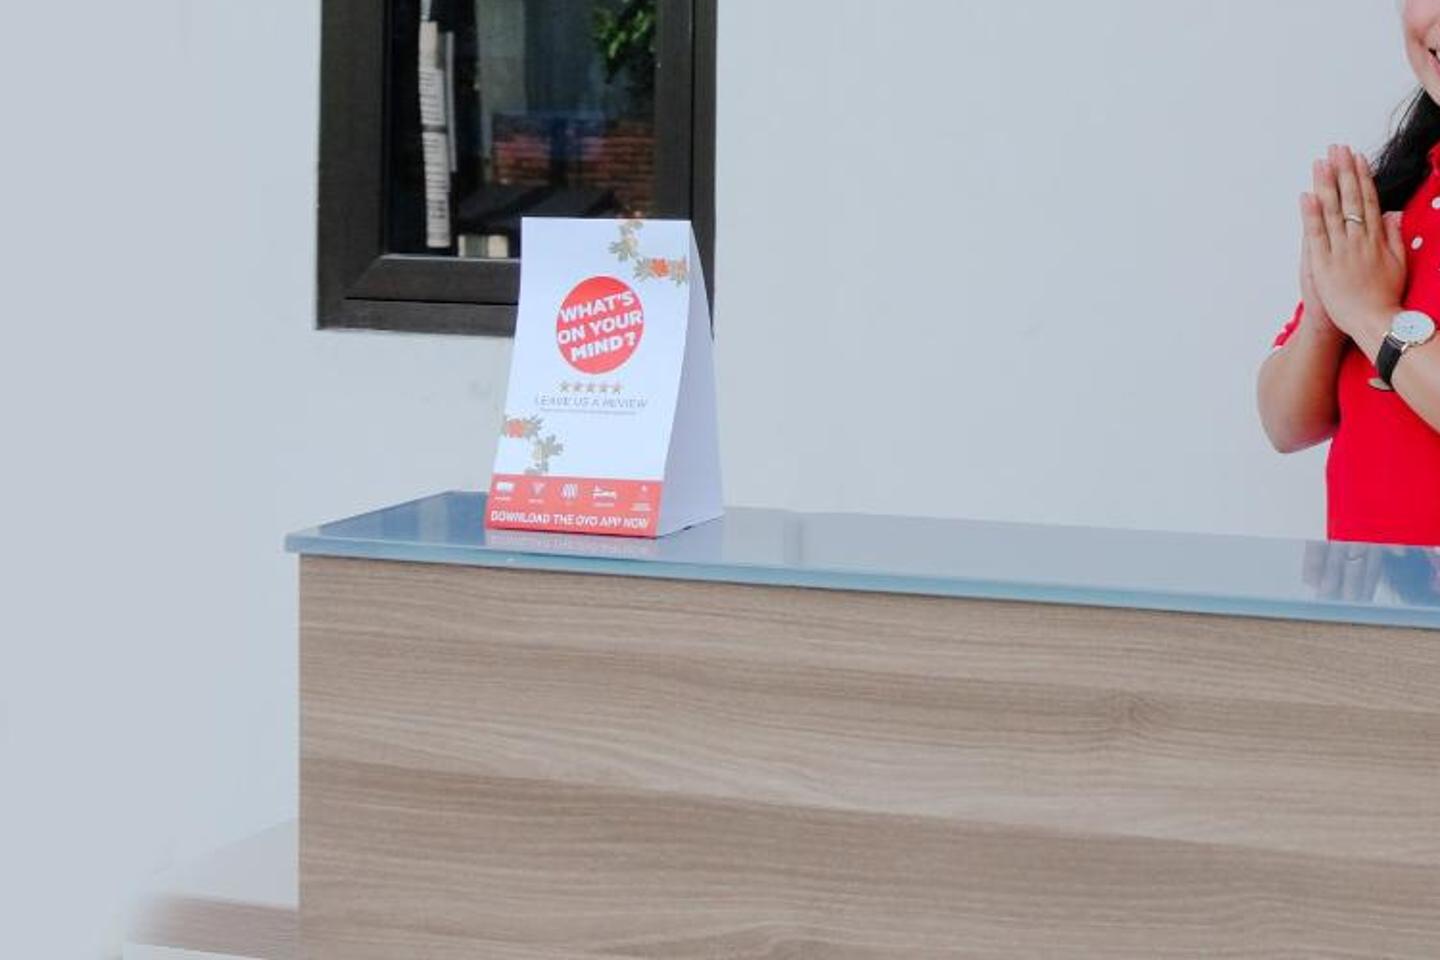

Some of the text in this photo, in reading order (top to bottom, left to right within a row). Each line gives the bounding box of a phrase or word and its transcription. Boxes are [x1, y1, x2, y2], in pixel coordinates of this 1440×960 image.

[560, 290, 634, 323] WHAT'S
[558, 310, 642, 344] ON YOUR
[491, 510, 550, 524] DOWNLOAD
[553, 514, 574, 526] THE
[575, 515, 598, 527] OYO
